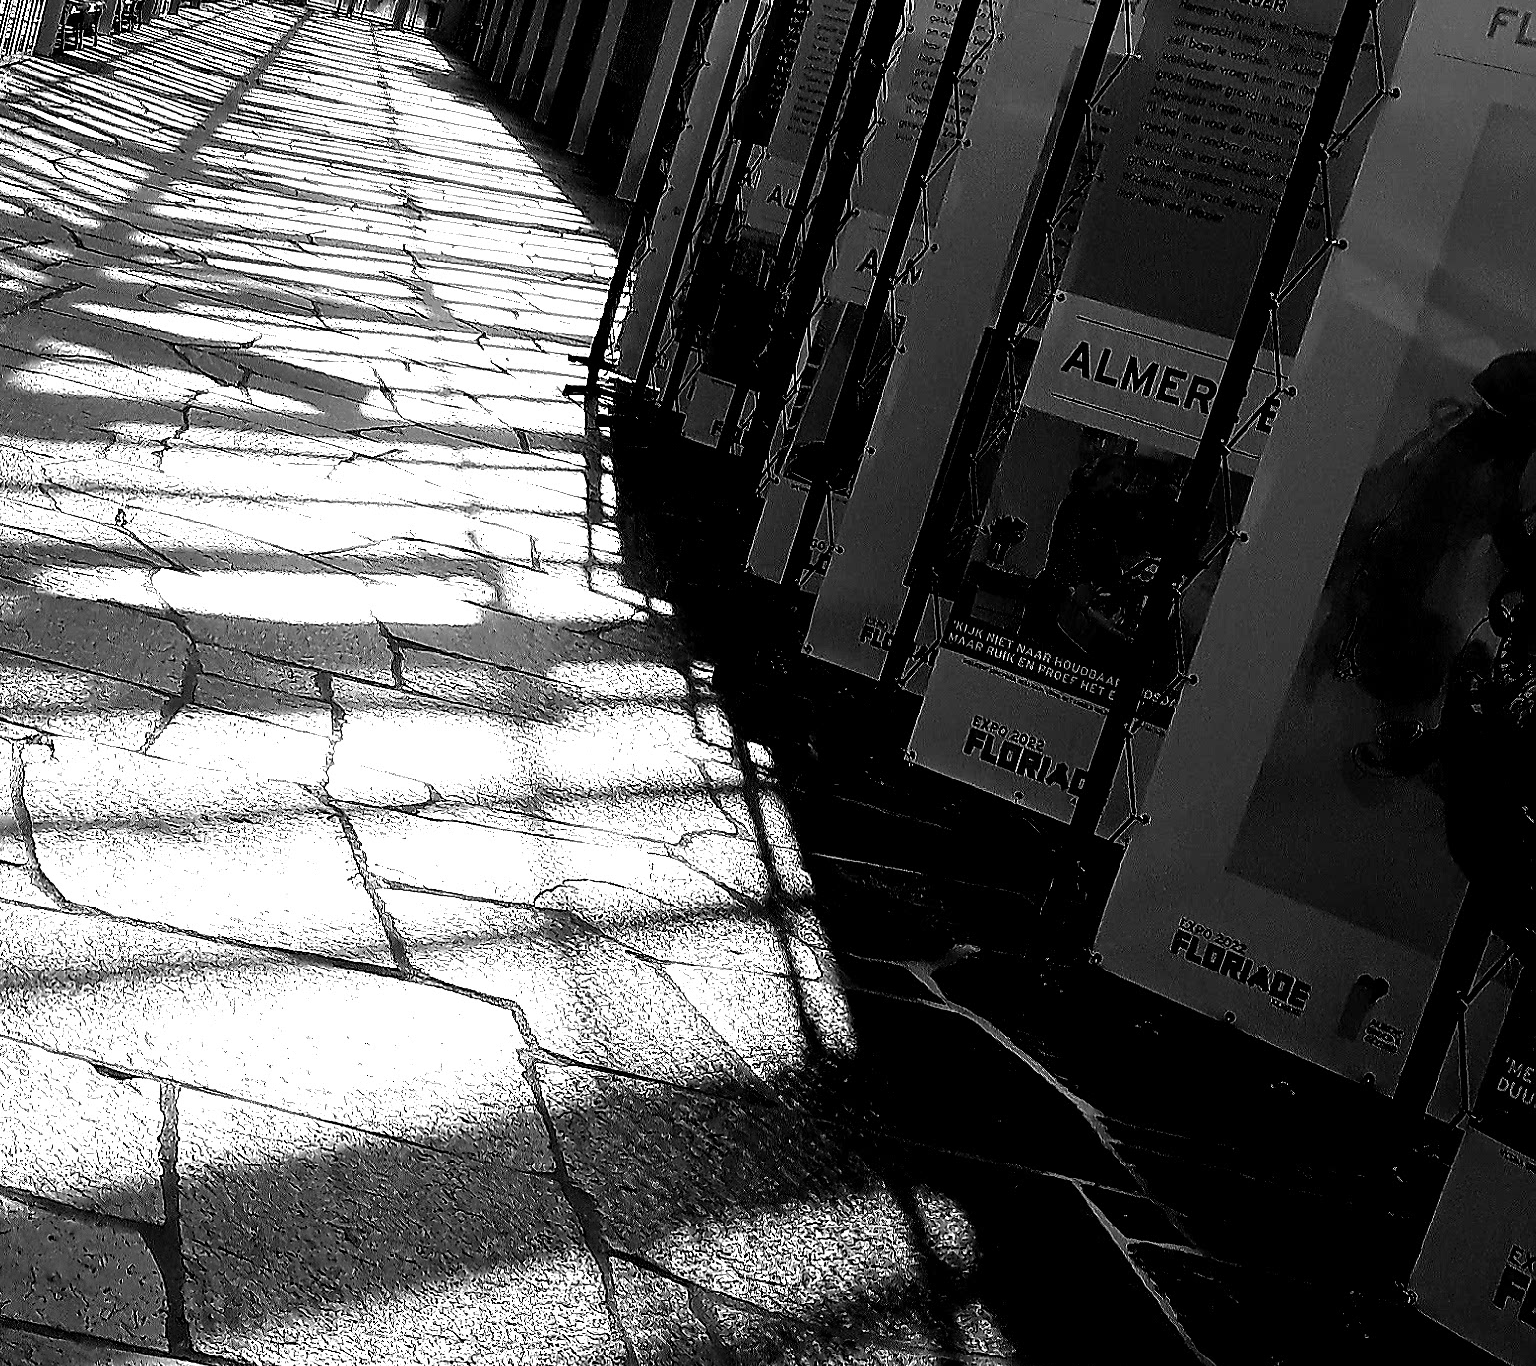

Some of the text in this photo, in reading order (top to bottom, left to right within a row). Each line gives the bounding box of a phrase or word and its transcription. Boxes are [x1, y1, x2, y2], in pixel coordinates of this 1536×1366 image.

[948, 632, 984, 652] MAAR
[986, 646, 1015, 664] RUIK
[1018, 657, 1034, 671] EN
[1037, 663, 1078, 686] PROEF
[1080, 679, 1106, 697] HET
[986, 633, 1014, 650] NIET
[1016, 643, 1052, 663] NAAR
[971, 713, 1046, 753] EXPO 2022
[1180, 916, 1248, 956] EXPO 2022
[1169, 927, 1312, 1011] FLORIADE
